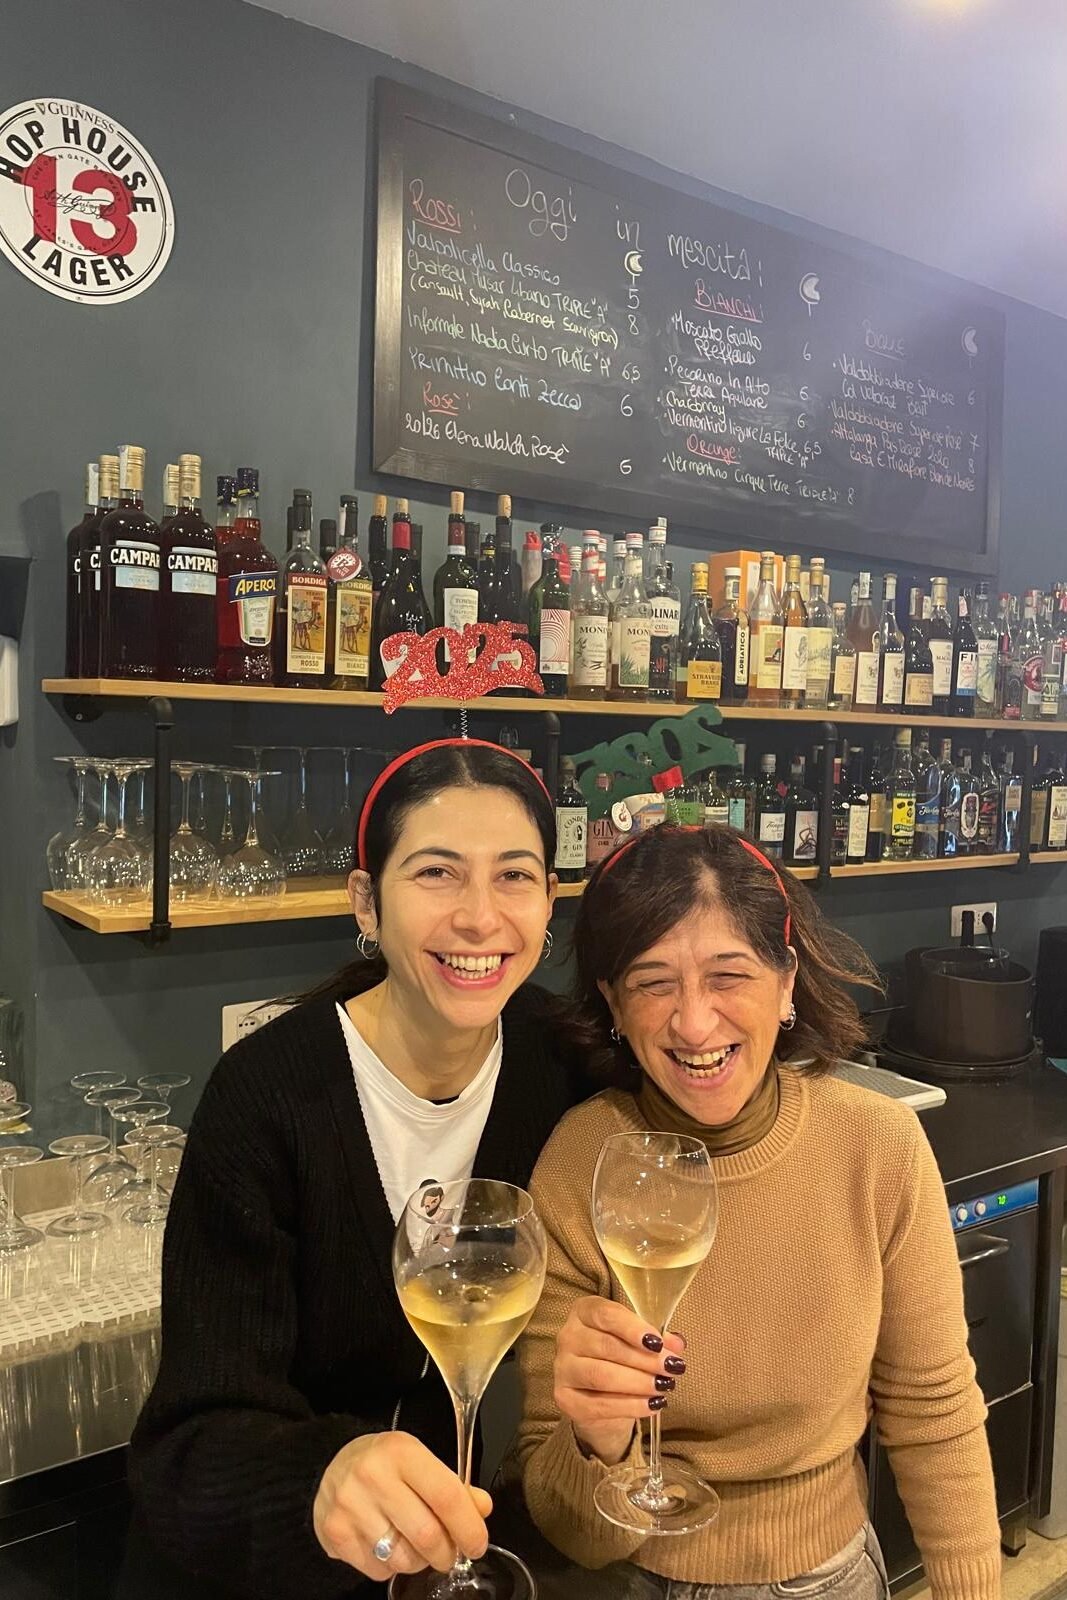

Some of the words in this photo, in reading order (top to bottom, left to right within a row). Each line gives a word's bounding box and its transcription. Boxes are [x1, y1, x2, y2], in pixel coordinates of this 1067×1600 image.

[48, 101, 115, 135] GUINNESS
[0, 119, 45, 184] HOP
[62, 117, 156, 213] HOUSE
[15, 153, 137, 258] 13
[505, 168, 577, 242] Oggi
[615, 203, 646, 252] in
[22, 234, 135, 286] LAGER
[502, 251, 561, 286] Classico
[627, 288, 641, 310] 5
[627, 314, 640, 335] 8
[802, 342, 812, 361] 6
[620, 394, 634, 417] 6
[799, 385, 809, 401] 6
[797, 412, 807, 429] 6
[619, 459, 633, 475] 6
[380, 620, 545, 715] 2025
